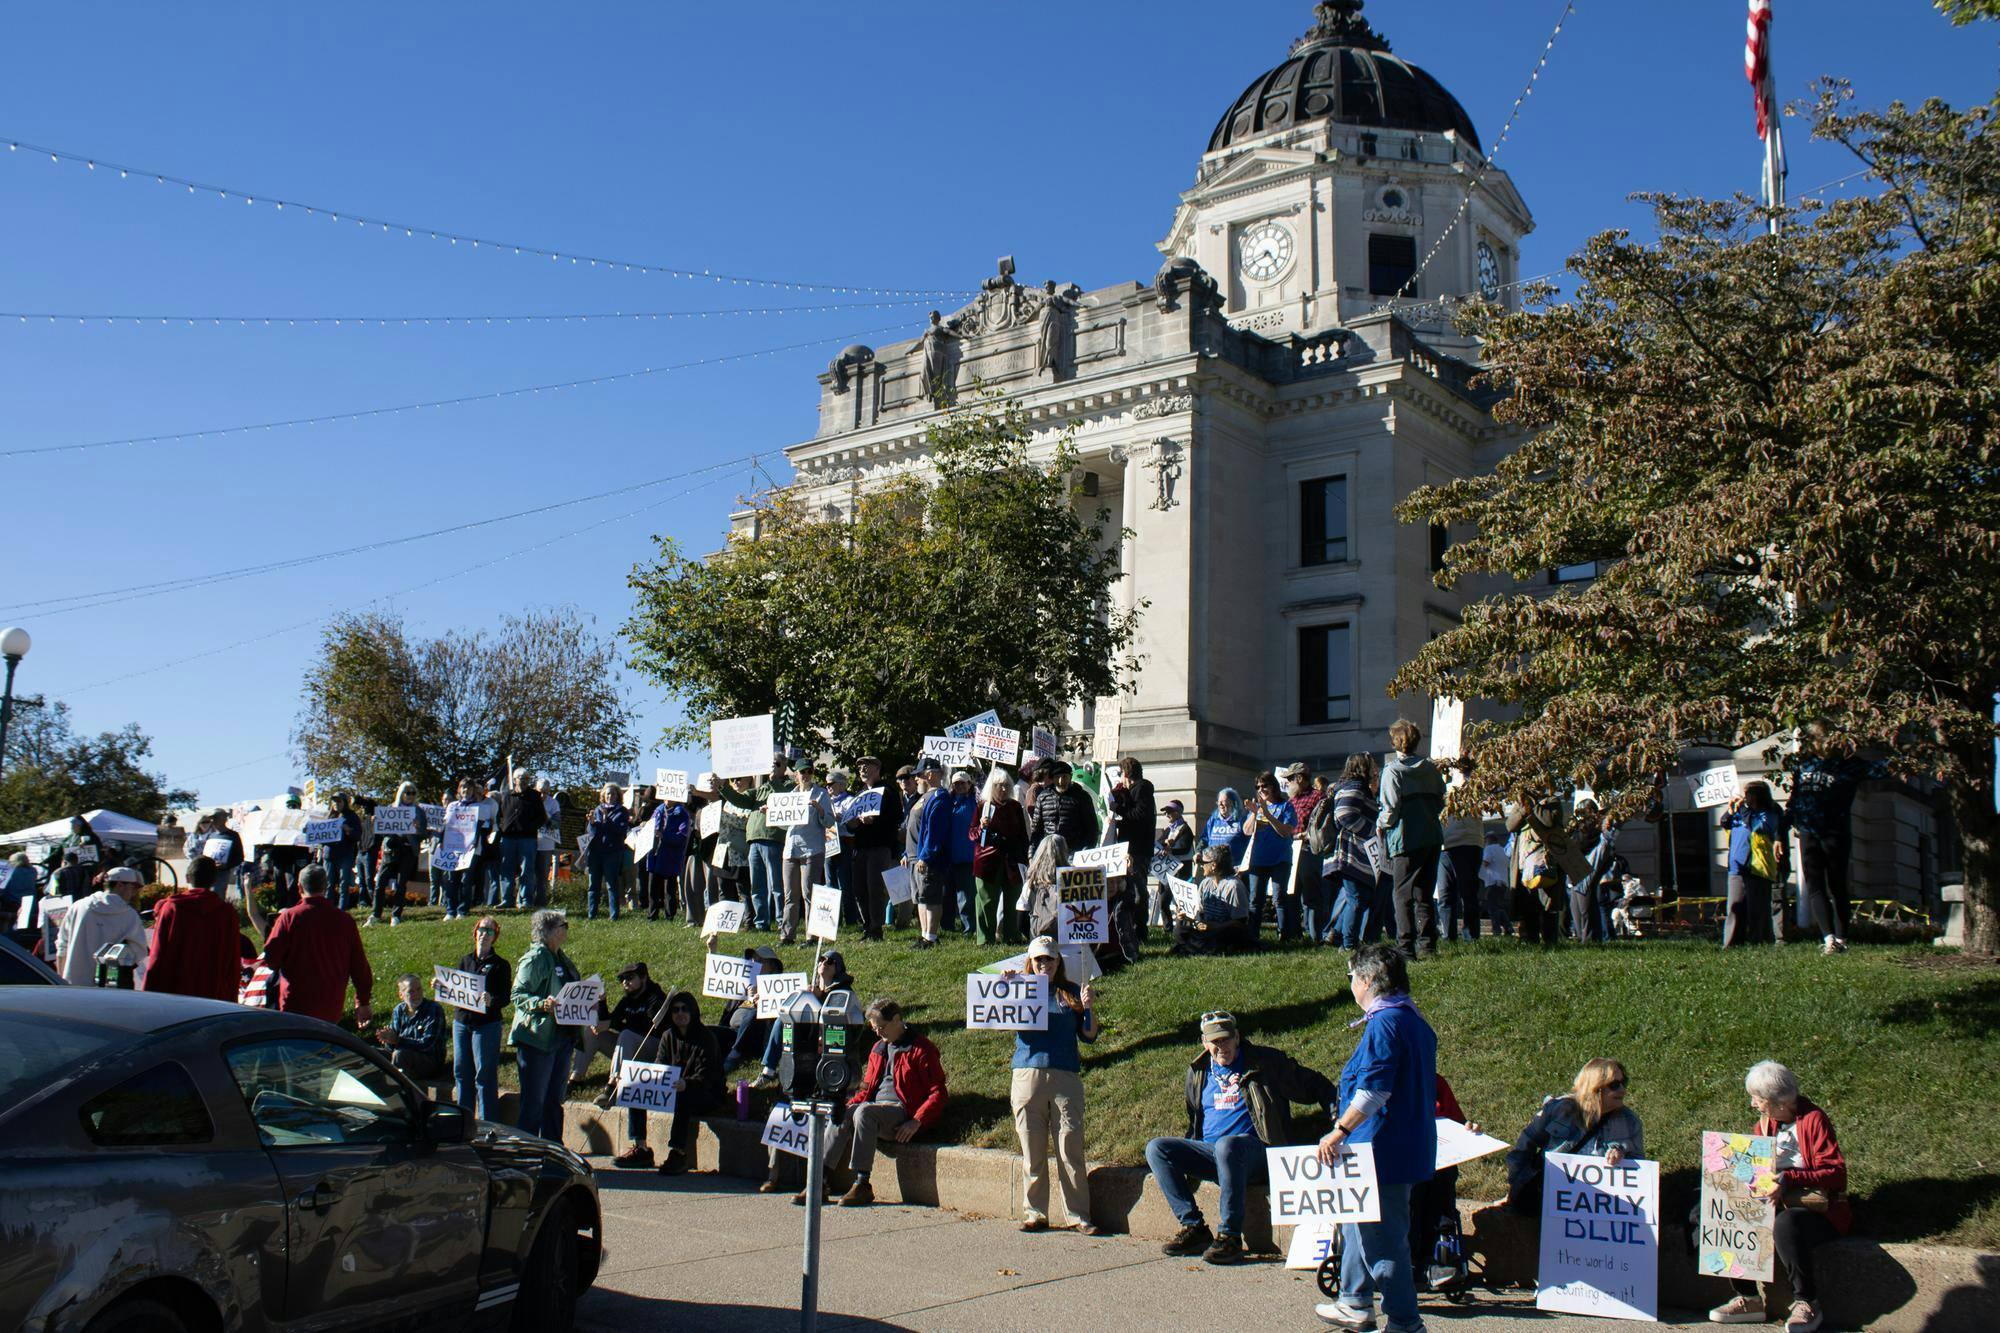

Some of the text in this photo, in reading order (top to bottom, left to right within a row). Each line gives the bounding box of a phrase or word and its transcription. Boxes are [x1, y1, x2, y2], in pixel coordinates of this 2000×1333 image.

[952, 716, 995, 738] DEENCY
[984, 726, 1012, 739] CRACK
[930, 740, 966, 752] VOTE
[986, 738, 1006, 750] THE
[985, 750, 1005, 761] ICE
[661, 773, 684, 784] VOTE
[1694, 770, 1731, 787] VOTE
[659, 785, 686, 798] EARLY
[850, 793, 877, 807] OTE
[1697, 786, 1735, 803] EARLY
[772, 795, 805, 807] VOTE
[848, 802, 877, 817] ARLY
[379, 809, 409, 819] VOTE
[426, 816, 446, 826] ARLY
[769, 809, 806, 822] EARLY
[311, 821, 337, 831] VOTE
[377, 821, 411, 832] EARLY
[308, 830, 340, 841] EARLY
[440, 851, 463, 860] VOT
[1081, 847, 1121, 863] VOTE
[434, 860, 457, 869] EAR
[1061, 870, 1103, 887] VOTE
[1060, 885, 1105, 903] EARLY
[1179, 900, 1196, 918] RLY
[718, 920, 736, 930] RLY
[1073, 923, 1095, 933] NO
[1068, 932, 1098, 940] KINGS
[712, 959, 753, 979] VOTE
[440, 970, 479, 992] VOTE
[707, 978, 749, 996] EARLY
[763, 978, 801, 994] VOTE
[977, 980, 1038, 999] VOTE
[438, 986, 482, 1009] EARLY
[562, 985, 599, 1001] VOTE
[556, 1003, 593, 1021] EARLY
[972, 1005, 1043, 1024] EARLY
[627, 1066, 673, 1086] VOTE
[620, 1086, 673, 1108] EARLY
[768, 1124, 809, 1150] EAR
[1280, 1152, 1362, 1181] VOTE
[1562, 1162, 1639, 1188] VOTE
[1279, 1186, 1370, 1216] EARLY
[1556, 1190, 1645, 1217] EARLY
[1711, 1198, 1735, 1221] No
[1565, 1218, 1646, 1245] BLUE
[1558, 1249, 1630, 1272] the world is
[1554, 1284, 1600, 1306] counting
[1620, 1285, 1636, 1304] it!
